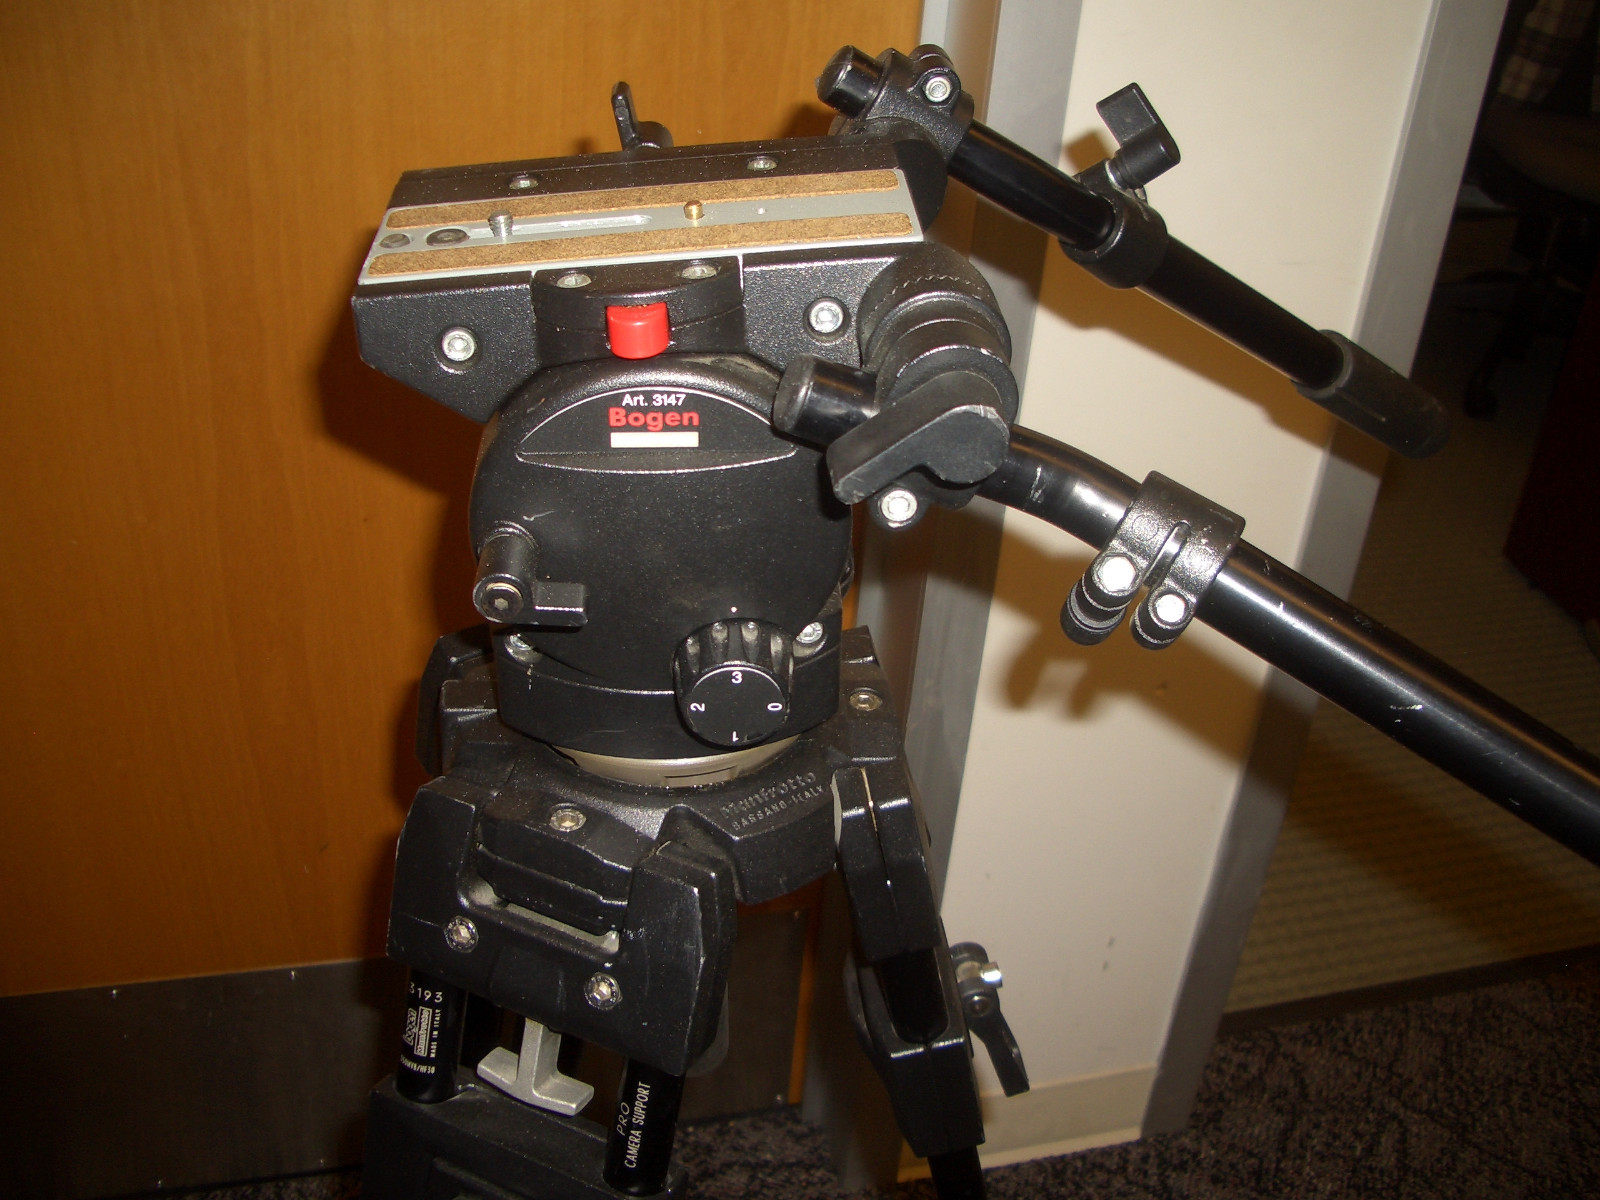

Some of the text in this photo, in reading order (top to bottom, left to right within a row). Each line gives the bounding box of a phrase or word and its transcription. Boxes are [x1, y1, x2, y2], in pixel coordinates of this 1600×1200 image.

[621, 393, 687, 407] Art. 3147
[608, 406, 700, 432] Bogen
[731, 670, 743, 684] 3
[690, 702, 706, 712] 2
[767, 702, 783, 711] 0
[732, 730, 740, 742] 1
[409, 982, 443, 1004] 3193
[429, 1009, 442, 1058] MADE IN ITALY
[616, 1101, 630, 1137] PRO
[624, 1081, 651, 1169] CAMERA SUPPORT
